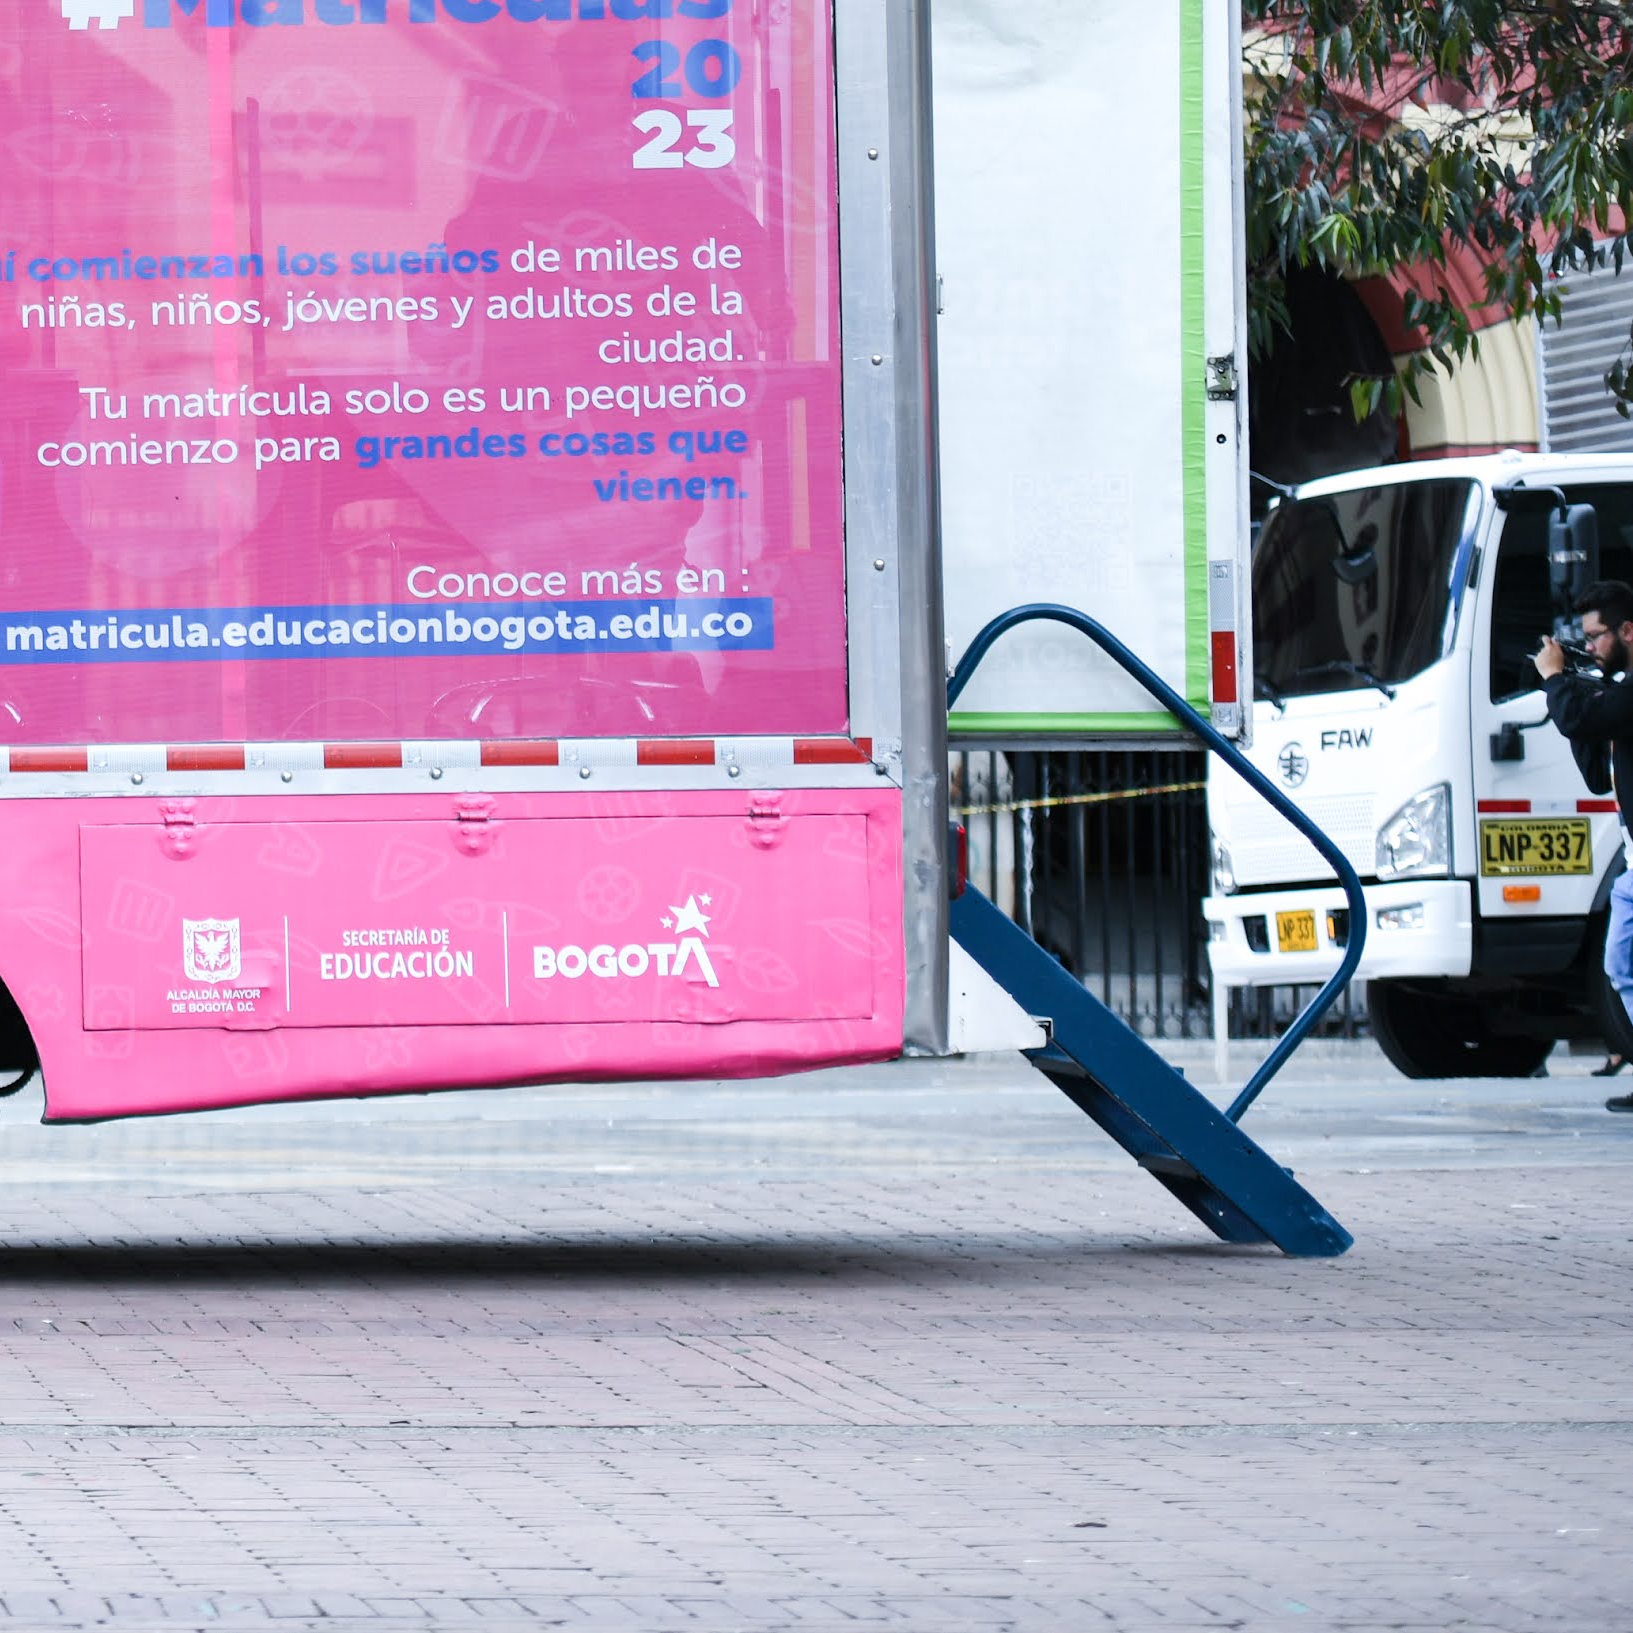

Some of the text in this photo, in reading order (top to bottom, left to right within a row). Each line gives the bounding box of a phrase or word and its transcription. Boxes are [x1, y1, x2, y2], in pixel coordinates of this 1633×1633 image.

[631, 39, 742, 99] 20
[632, 108, 736, 169] 23
[28, 249, 264, 282] comienzan
[278, 245, 336, 277] los
[351, 243, 500, 276] sueños
[511, 241, 561, 272] de
[575, 239, 679, 271] miles
[692, 238, 742, 269] de
[21, 284, 744, 331] niñas, niños, jóvenes y adultos de la
[598, 330, 744, 364] ciudad.
[79, 376, 746, 419] Tu matrícula solo es un pequeño
[38, 427, 748, 470] comienzo para grandes cosas que
[593, 471, 749, 502] vienen.
[406, 565, 567, 599] Conoce
[581, 562, 660, 596] más
[676, 570, 727, 595] en
[6, 607, 753, 651] matricula.educacionbogota.edu.co
[1321, 727, 1373, 750] FAW
[342, 926, 450, 946] SECRETARÍA DE
[320, 946, 475, 981] EDUCACIÓN
[166, 987, 261, 1001] ALCALDÍA MAYOR
[172, 1000, 256, 1014] DE BOGOTÁ D.C.
